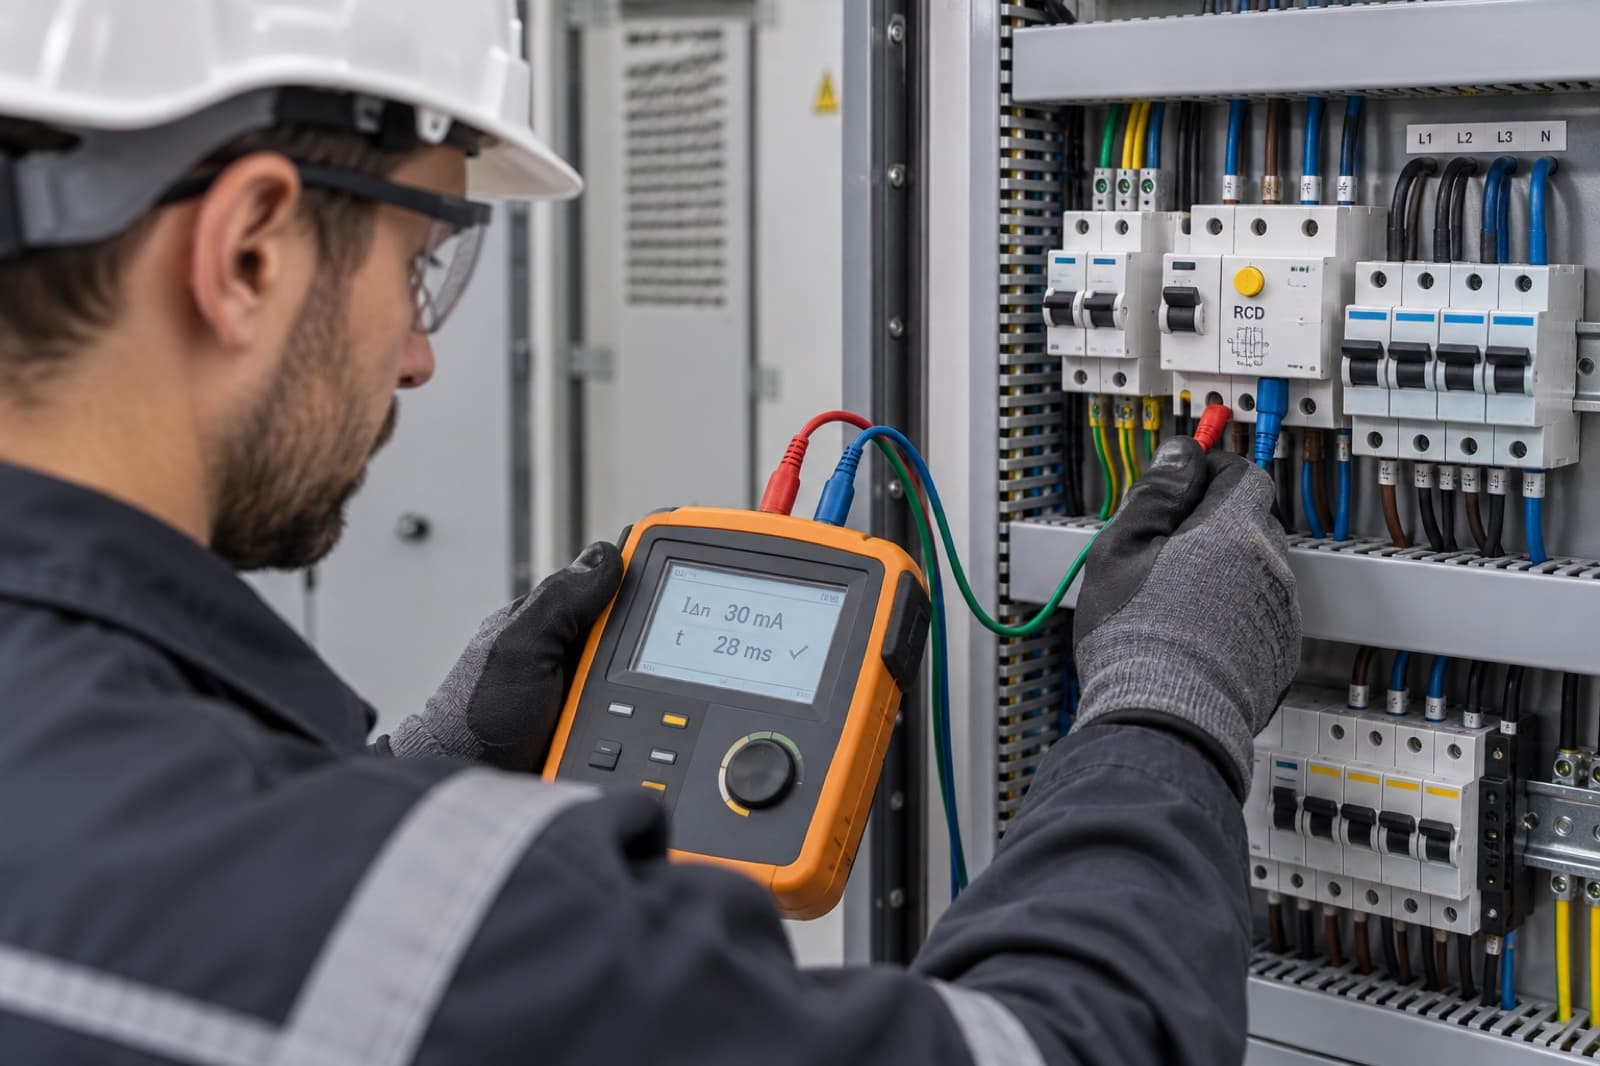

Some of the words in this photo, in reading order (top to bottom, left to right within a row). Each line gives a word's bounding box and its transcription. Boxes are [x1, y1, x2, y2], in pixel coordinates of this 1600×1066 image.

[1419, 132, 1432, 144] L1
[1457, 131, 1473, 144] L2
[1497, 130, 1513, 143] L3
[1541, 130, 1551, 143] N
[1233, 305, 1265, 320] RCD
[724, 603, 750, 624] 30
[753, 612, 783, 630] mA
[675, 629, 684, 646] t
[713, 635, 740, 656] 28
[743, 644, 773, 662] ms
